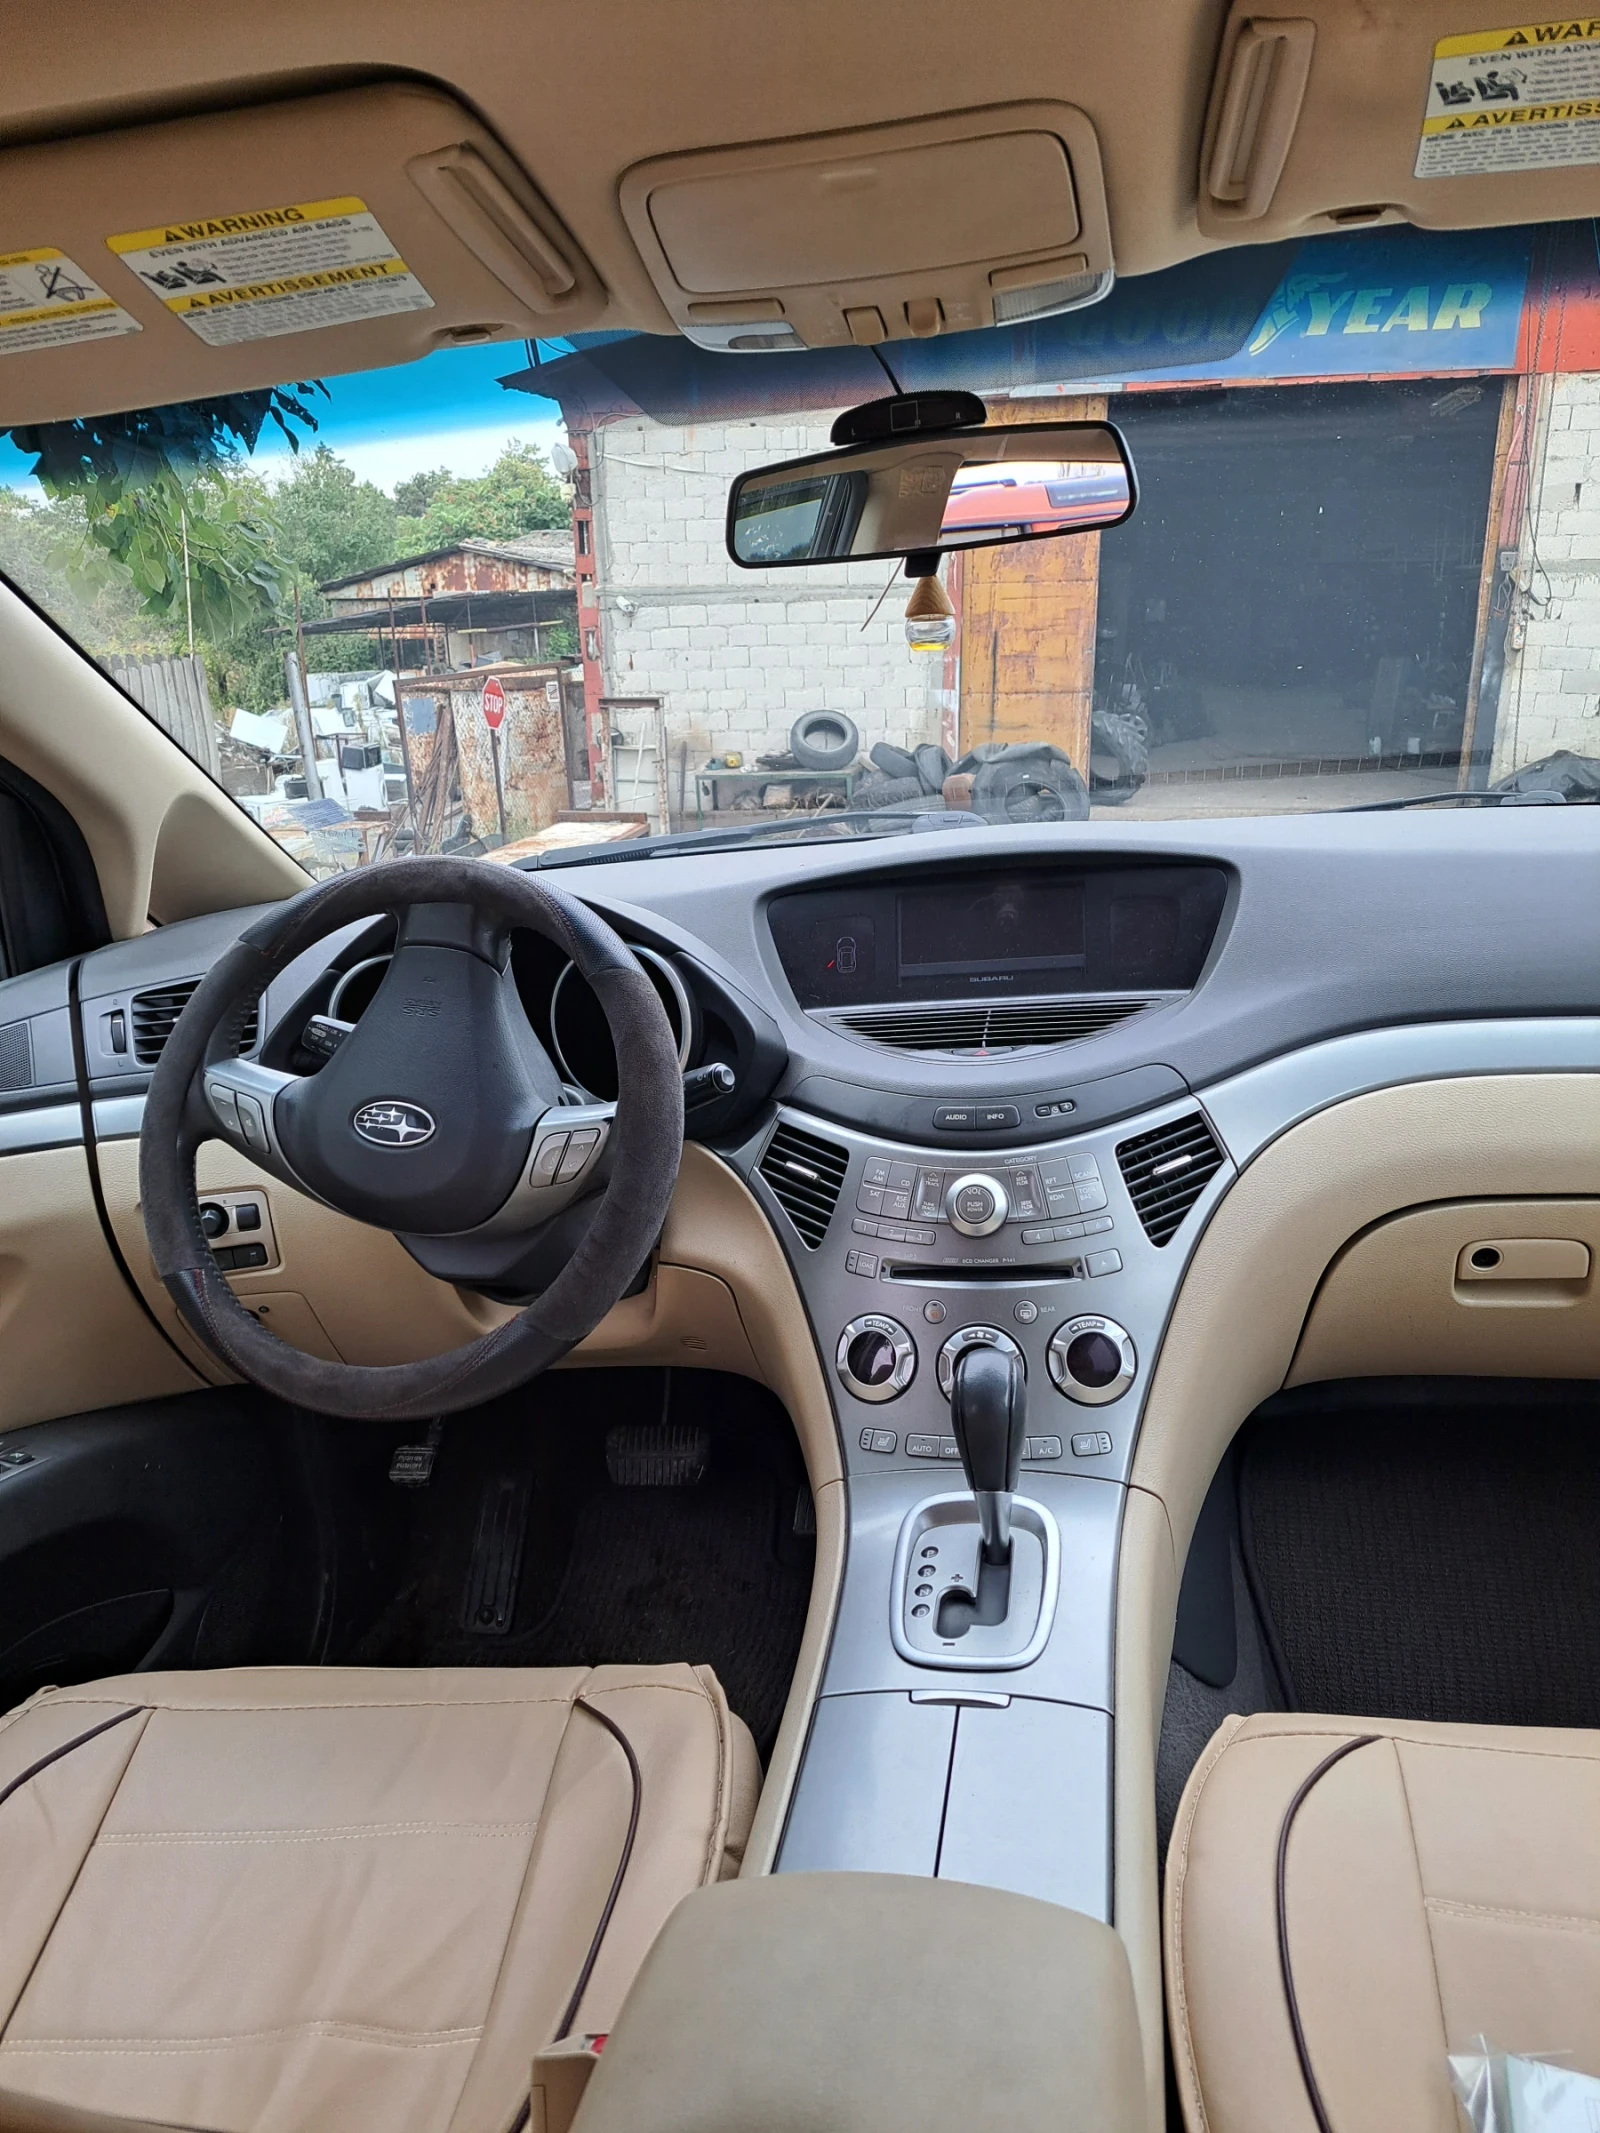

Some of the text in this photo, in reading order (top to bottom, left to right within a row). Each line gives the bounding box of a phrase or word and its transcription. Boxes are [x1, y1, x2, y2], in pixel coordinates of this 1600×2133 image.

[1469, 53, 1512, 65] EVEN
[1516, 48, 1556, 59] WITH
[179, 207, 305, 238] WARNING
[148, 247, 184, 258] EVEN
[186, 242, 217, 251] WITH
[221, 229, 288, 246] ADVANCED
[292, 225, 313, 234] AIR
[209, 264, 388, 304] AVERTISSEMENT
[1304, 283, 1494, 336] YEAR
[955, 412, 961, 420] R
[484, 692, 503, 714] STOP
[1004, 1155, 1037, 1165] CATEGORY
[875, 1168, 885, 1176] FM
[1074, 1171, 1092, 1179] SCAN
[900, 1179, 910, 1187] CD
[1045, 1177, 1057, 1185] RPT
[966, 1187, 982, 1195] VOL
[896, 1195, 908, 1203] RSE
[892, 1201, 906, 1209] AUX
[1066, 1228, 1072, 1236] 5
[917, 1233, 923, 1241] 3
[902, 1305, 922, 1313] FRONT
[1040, 1305, 1056, 1313] REAR
[872, 1320, 890, 1330] TEMP
[1076, 1320, 1097, 1329] TEMP
[912, 1445, 932, 1453] AUTO
[1038, 1447, 1053, 1455] A/C
[926, 1549, 935, 1559] P
[923, 1568, 932, 1577] R
[919, 1588, 929, 1597] N
